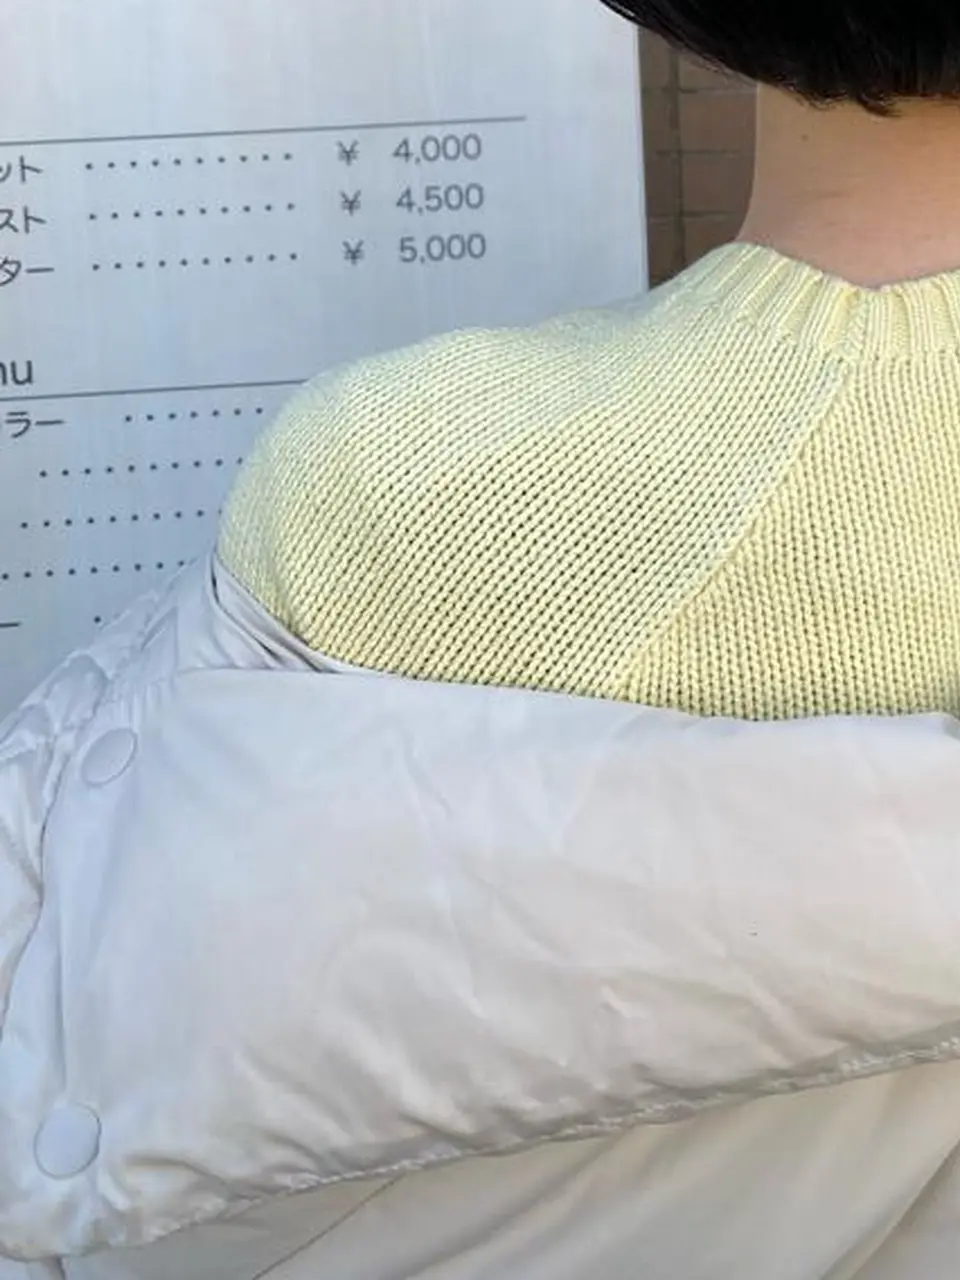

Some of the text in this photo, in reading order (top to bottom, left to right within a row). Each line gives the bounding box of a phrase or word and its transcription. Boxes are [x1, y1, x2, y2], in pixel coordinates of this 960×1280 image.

[336, 140, 360, 166] ¥
[392, 133, 482, 166] 4,000
[340, 190, 362, 216] ¥
[395, 183, 484, 215] 4,500
[342, 240, 364, 265] ¥
[399, 233, 487, 264] 5,000
